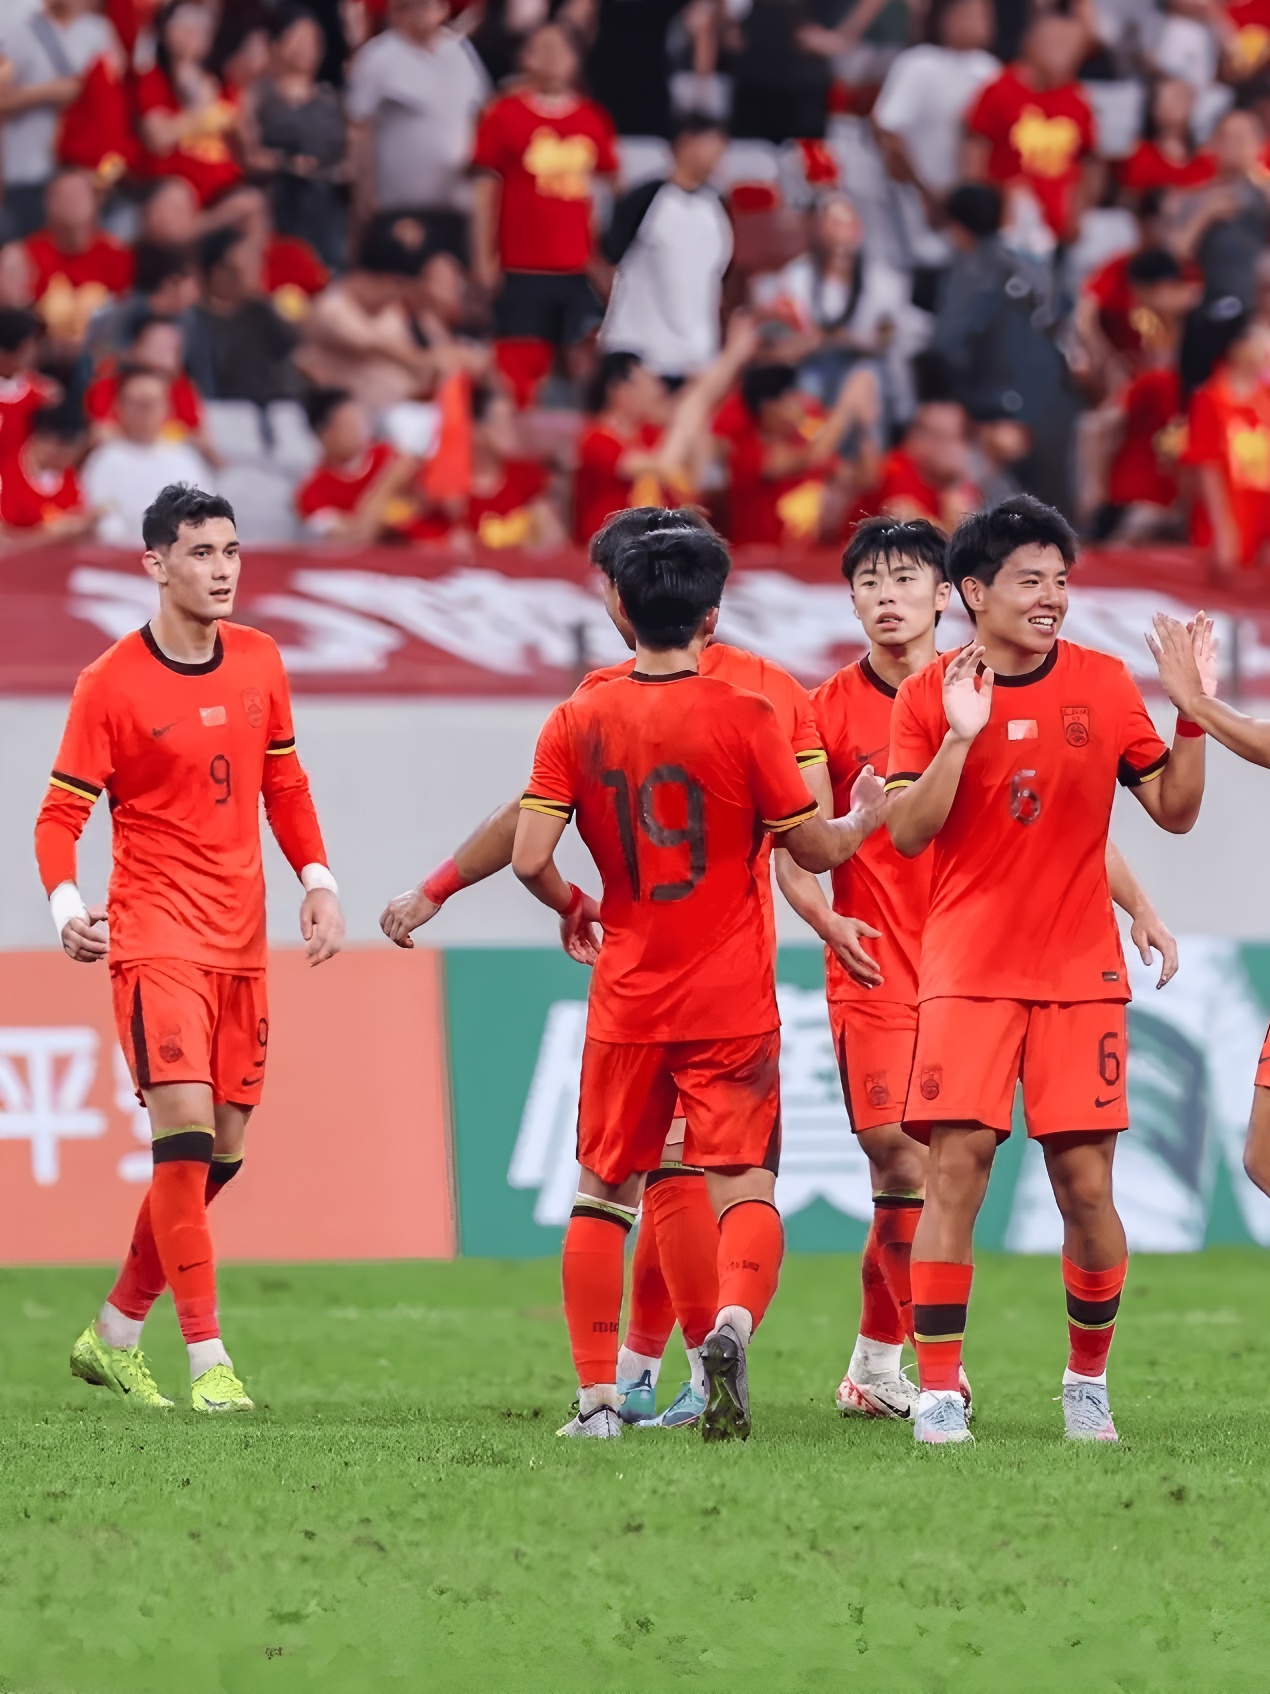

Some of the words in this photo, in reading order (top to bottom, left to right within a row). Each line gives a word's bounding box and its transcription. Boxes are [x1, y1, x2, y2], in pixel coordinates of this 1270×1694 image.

[210, 753, 231, 805] 9
[1010, 768, 1041, 826] 6
[602, 764, 708, 903] 19
[253, 1017, 269, 1068] 9
[1098, 1031, 1120, 1086] 6
[0, 1026, 154, 1187] 平
